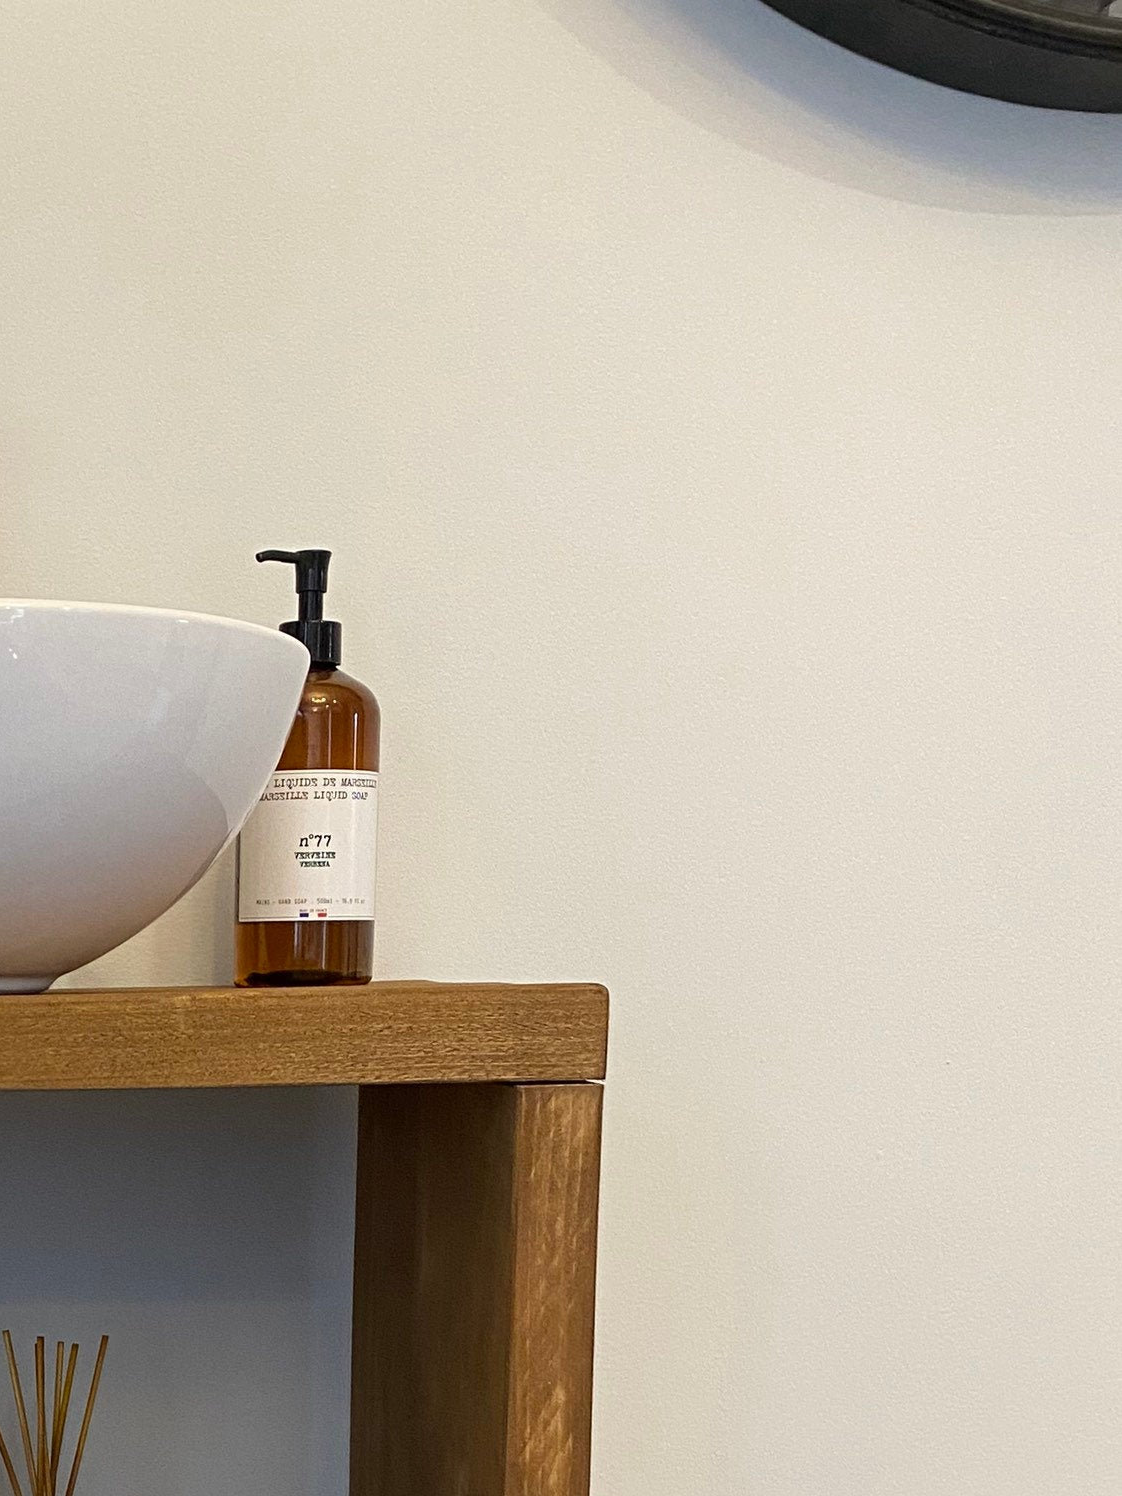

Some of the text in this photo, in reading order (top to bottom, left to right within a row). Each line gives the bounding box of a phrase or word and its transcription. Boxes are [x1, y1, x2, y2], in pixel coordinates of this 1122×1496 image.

[274, 778, 318, 789] LIQUIDE
[323, 778, 336, 787] DE
[313, 791, 348, 801] LIQUID
[351, 791, 368, 800] SOAP
